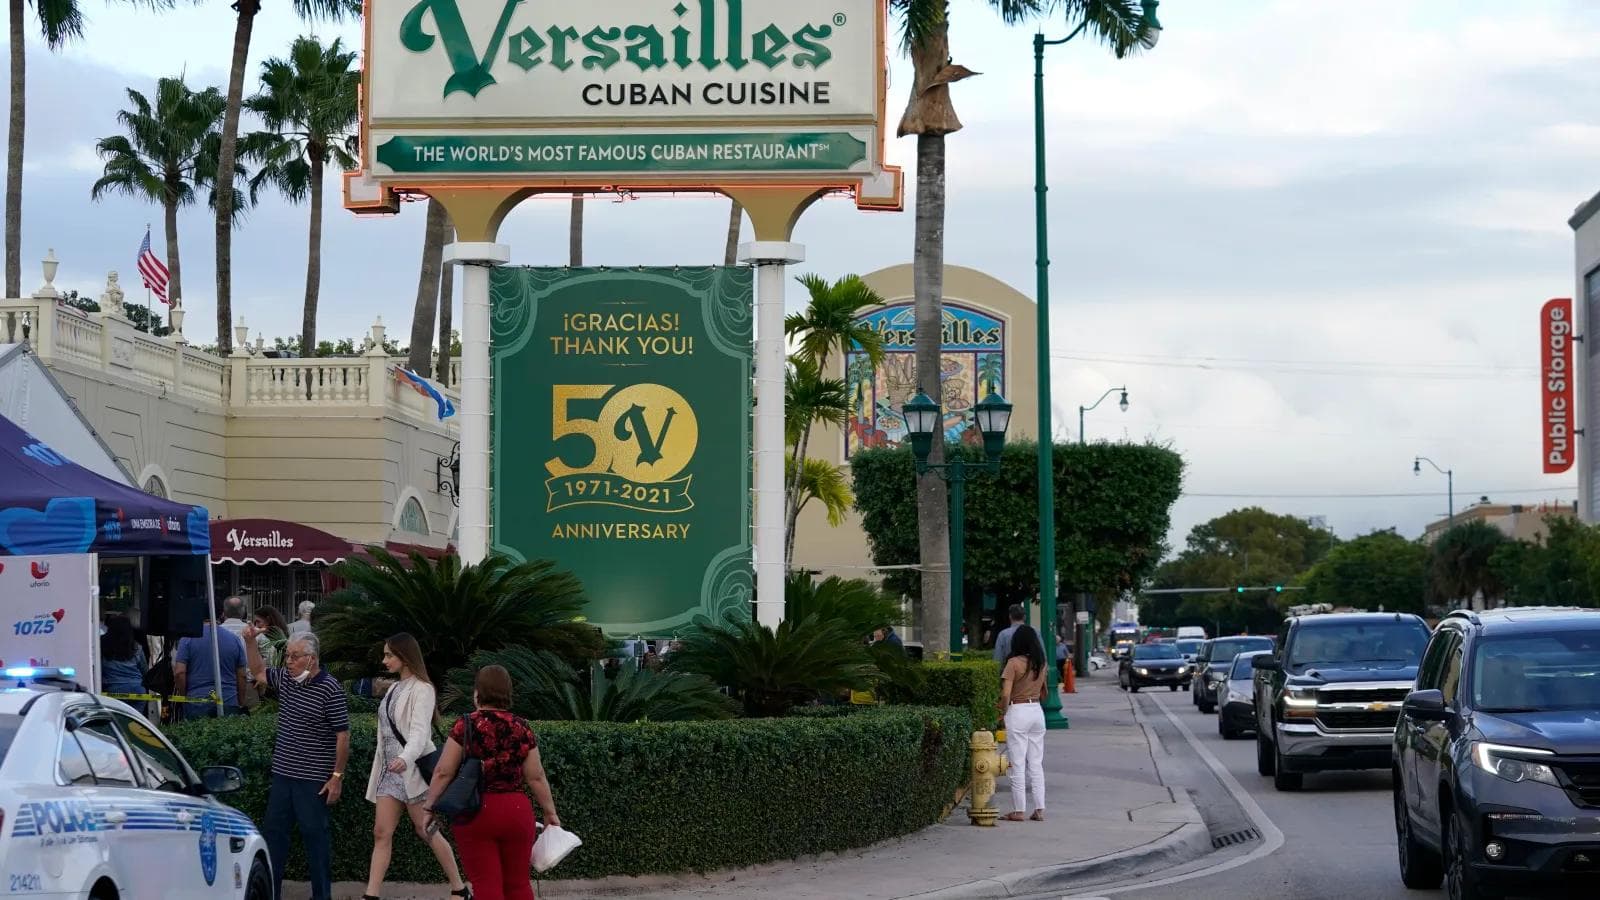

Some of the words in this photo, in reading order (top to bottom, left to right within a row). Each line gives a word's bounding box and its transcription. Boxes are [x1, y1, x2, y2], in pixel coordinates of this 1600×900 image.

[582, 83, 692, 106] CUBAN
[702, 81, 831, 104] CUISINE
[413, 145, 446, 162] THE
[450, 145, 524, 162] WORLD'S
[528, 144, 574, 161] MOST
[578, 144, 647, 161] FAMOUS
[651, 143, 708, 160] CUBAN
[562, 313, 680, 332] ¡GRACIAS!
[550, 336, 630, 356] THANK
[636, 336, 694, 356] YOU!
[1548, 306, 1571, 392] Storage
[1548, 396, 1567, 465] Public
[563, 479, 672, 504] 1971-2021
[226, 528, 294, 552] Versailles
[551, 523, 691, 539] ANNIVERSARY
[13, 620, 55, 635] 107.5
